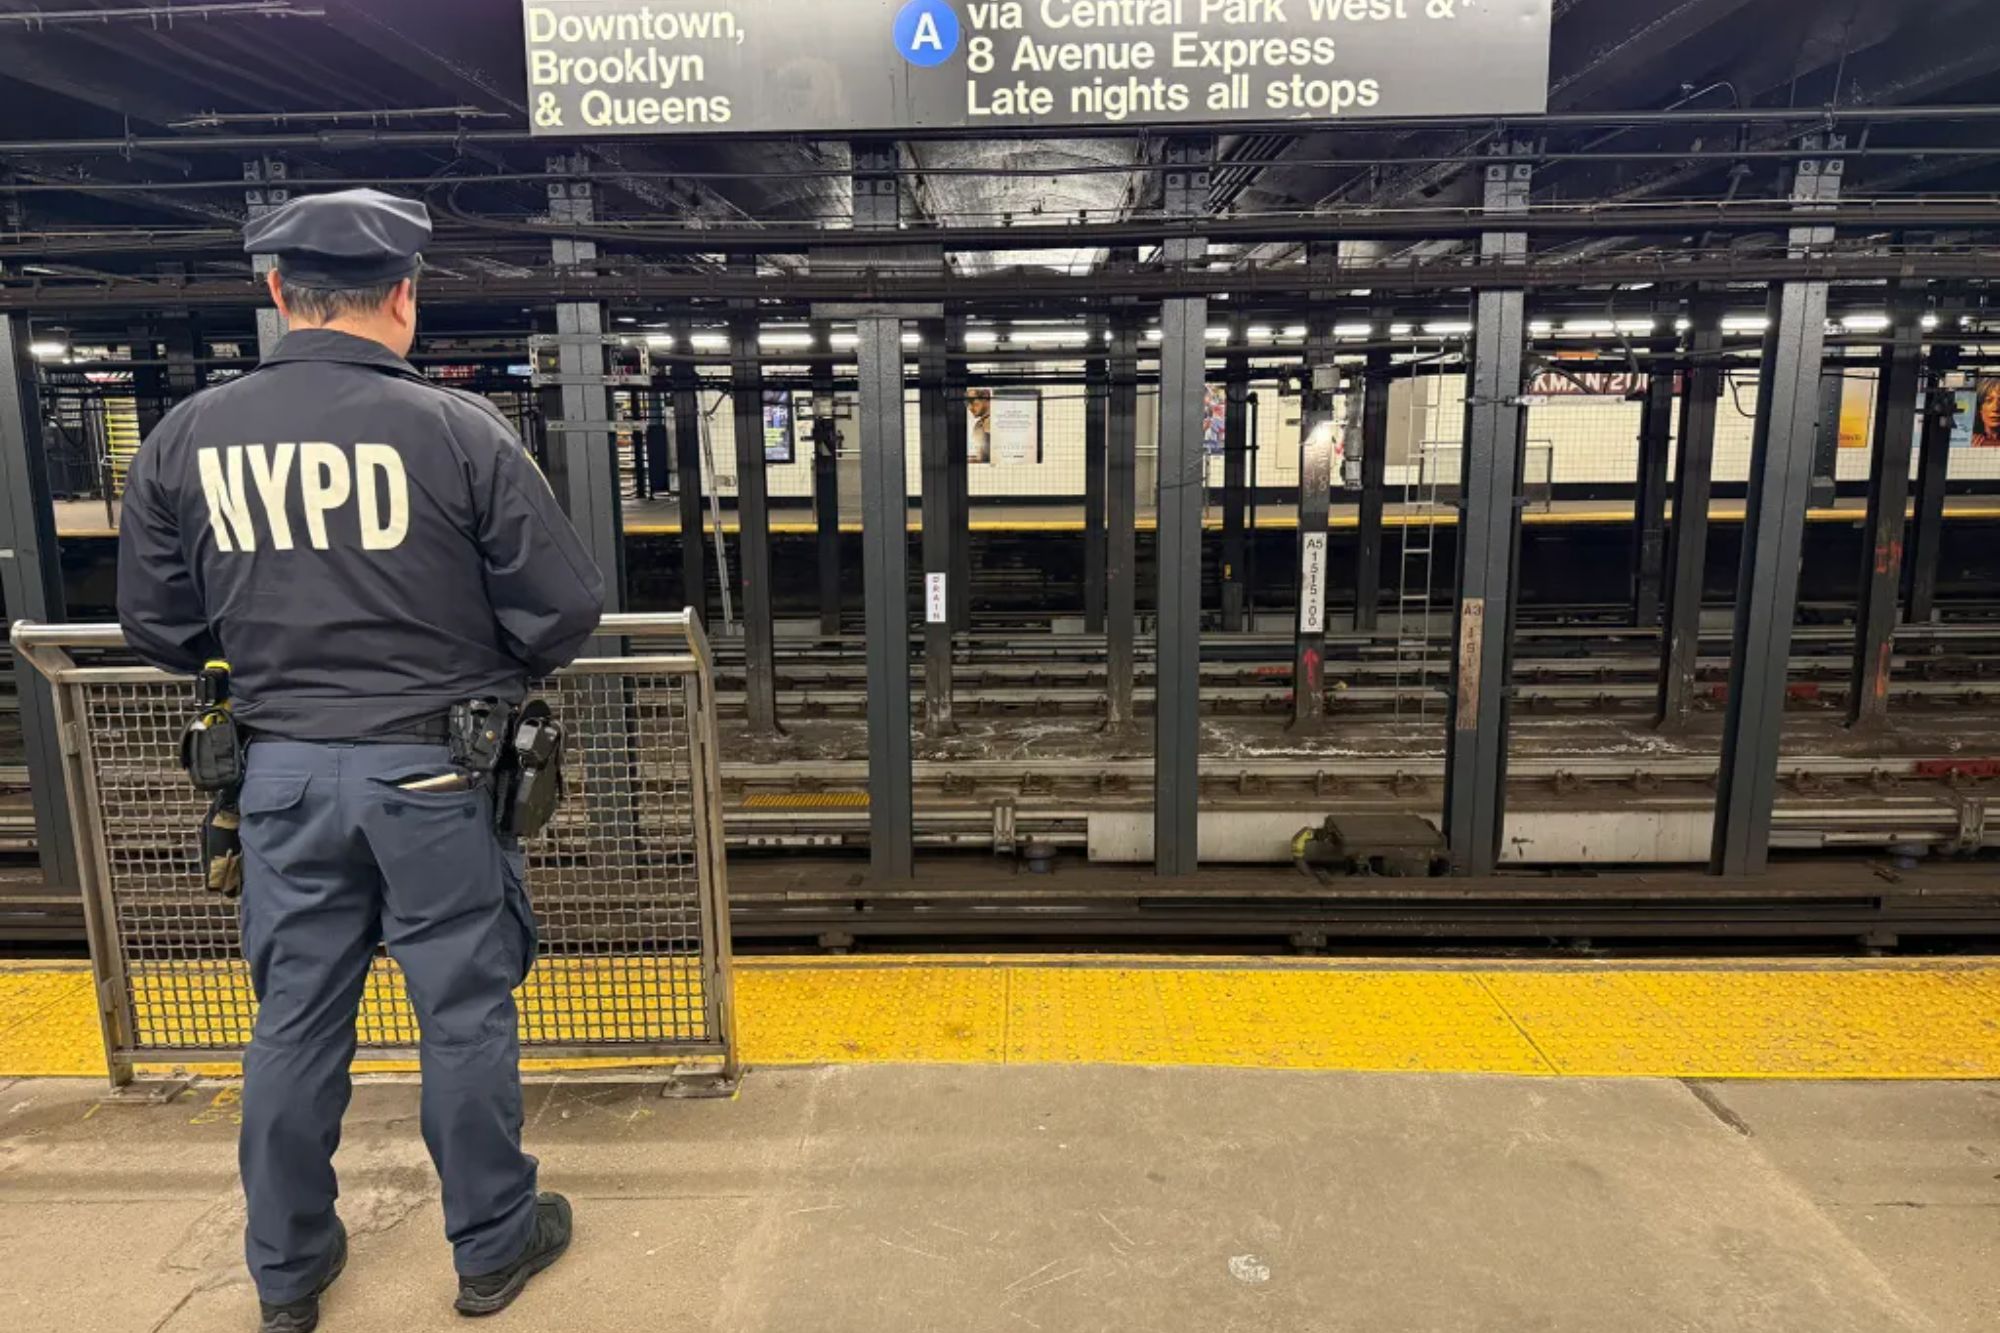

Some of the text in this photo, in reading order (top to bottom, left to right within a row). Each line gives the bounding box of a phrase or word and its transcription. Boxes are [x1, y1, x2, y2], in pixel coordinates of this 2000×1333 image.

[529, 6, 745, 45] Downtown,
[910, 11, 943, 50] A
[967, 0, 1455, 29] via Central Park West &
[532, 47, 704, 89] Brooklyn
[967, 32, 1336, 74] 8 Avenue Express
[535, 89, 731, 126] & Queens
[967, 73, 1380, 120] Late nights all stops
[197, 442, 409, 552] NYPD
[1306, 538, 1323, 550] A5
